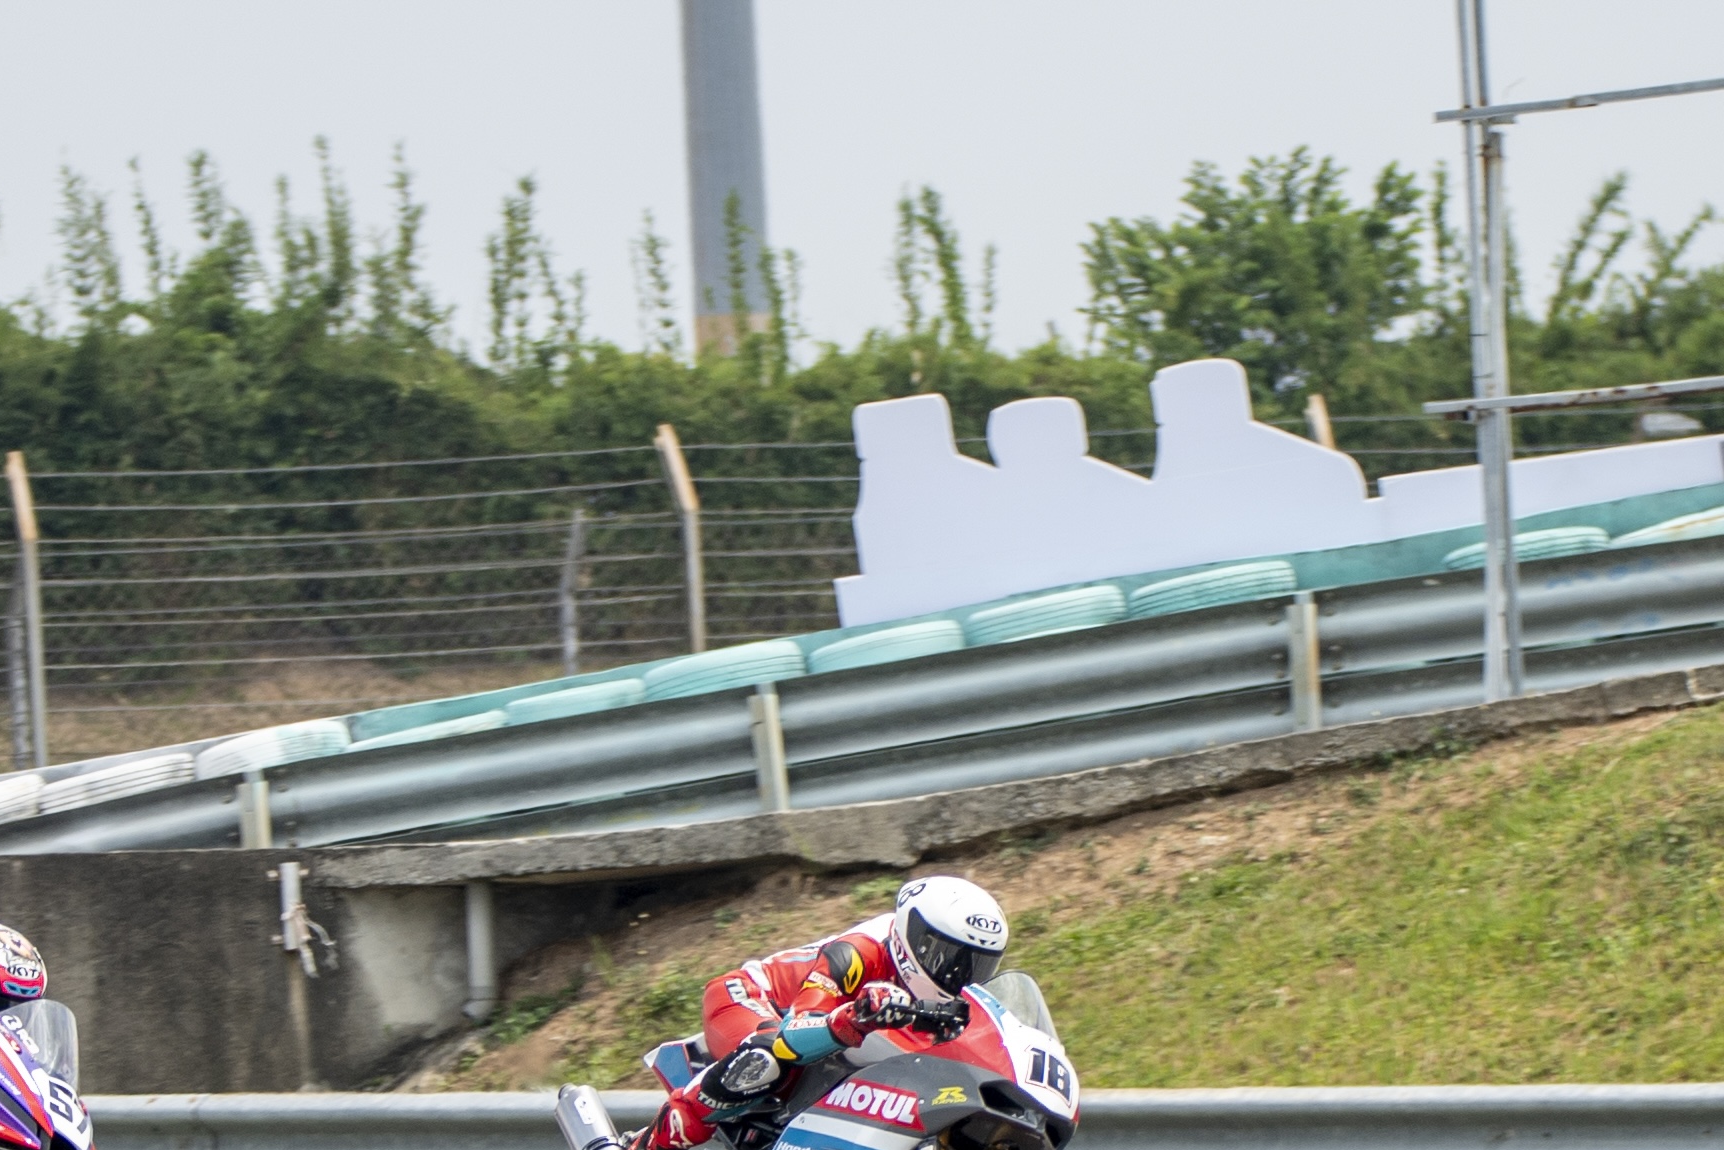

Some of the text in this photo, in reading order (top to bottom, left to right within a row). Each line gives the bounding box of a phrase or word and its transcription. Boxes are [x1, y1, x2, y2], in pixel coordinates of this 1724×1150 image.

[968, 915, 1000, 933] KYT
[1028, 1046, 1072, 1103] 18
[825, 1080, 918, 1125] MOTUL
